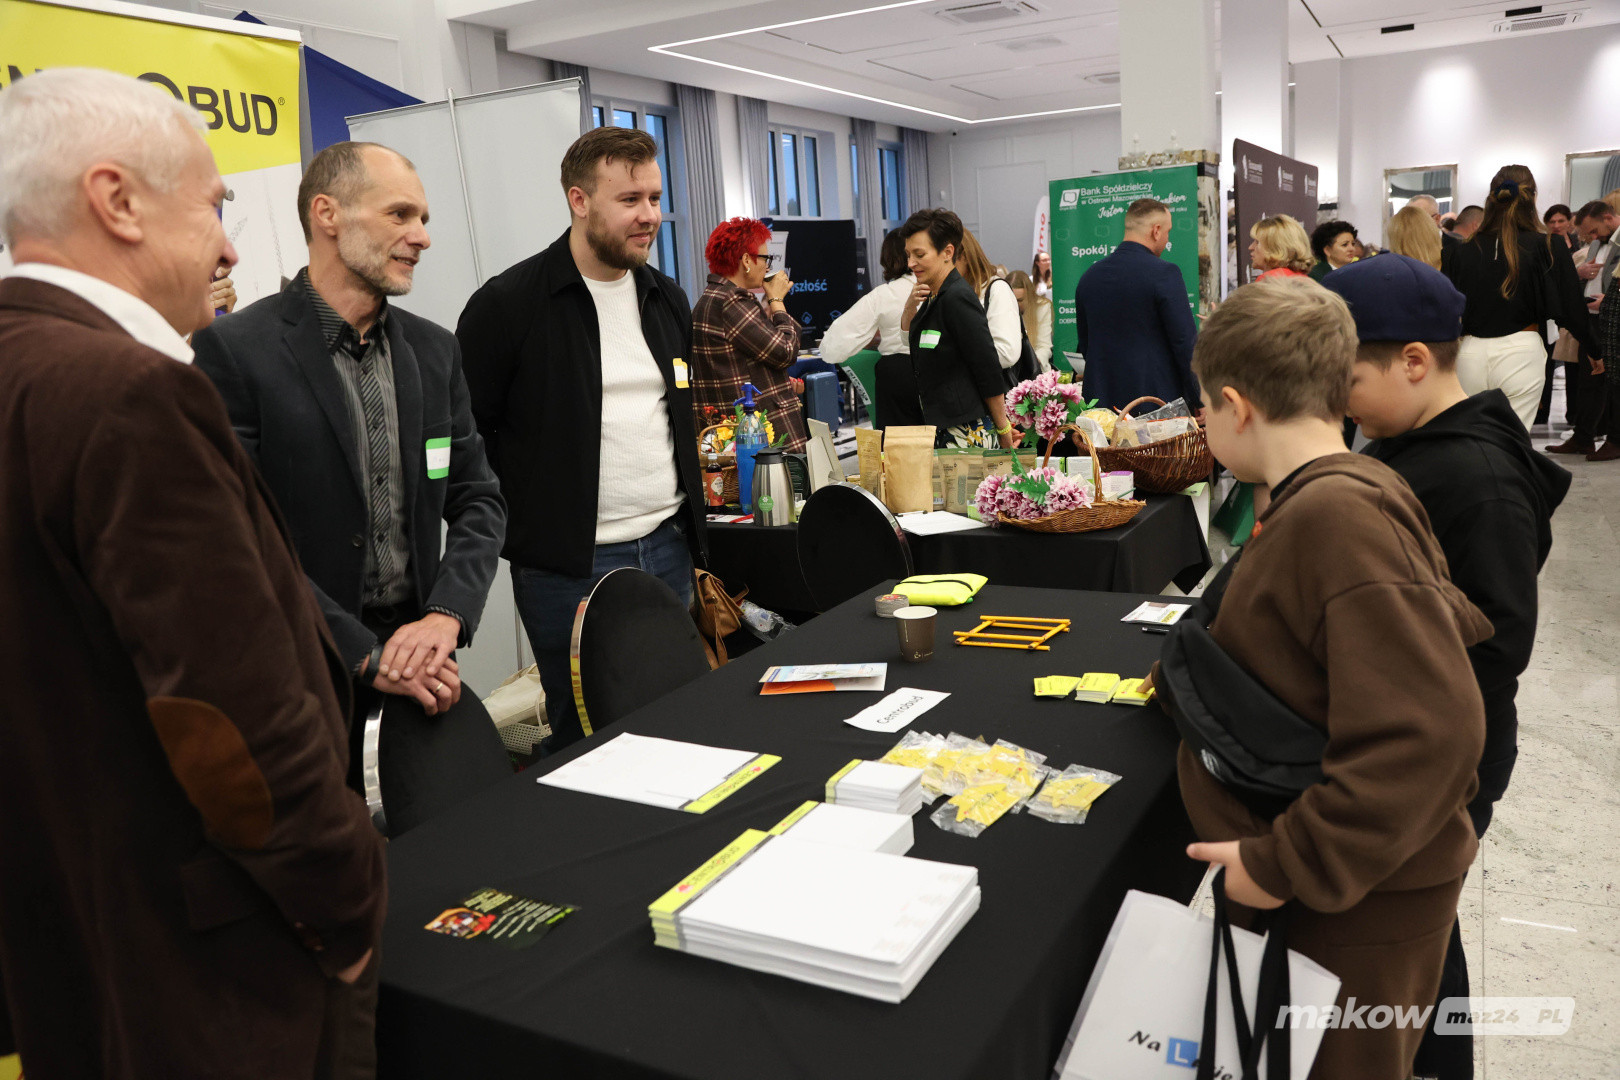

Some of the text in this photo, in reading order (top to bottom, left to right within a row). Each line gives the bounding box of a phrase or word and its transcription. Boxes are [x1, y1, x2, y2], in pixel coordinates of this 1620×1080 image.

[1081, 183, 1153, 196] Bank Spółdzielczy
[1072, 245, 1108, 257] Spokój
[876, 695, 923, 724] Centrobud
[1128, 1030, 1161, 1052] Na
